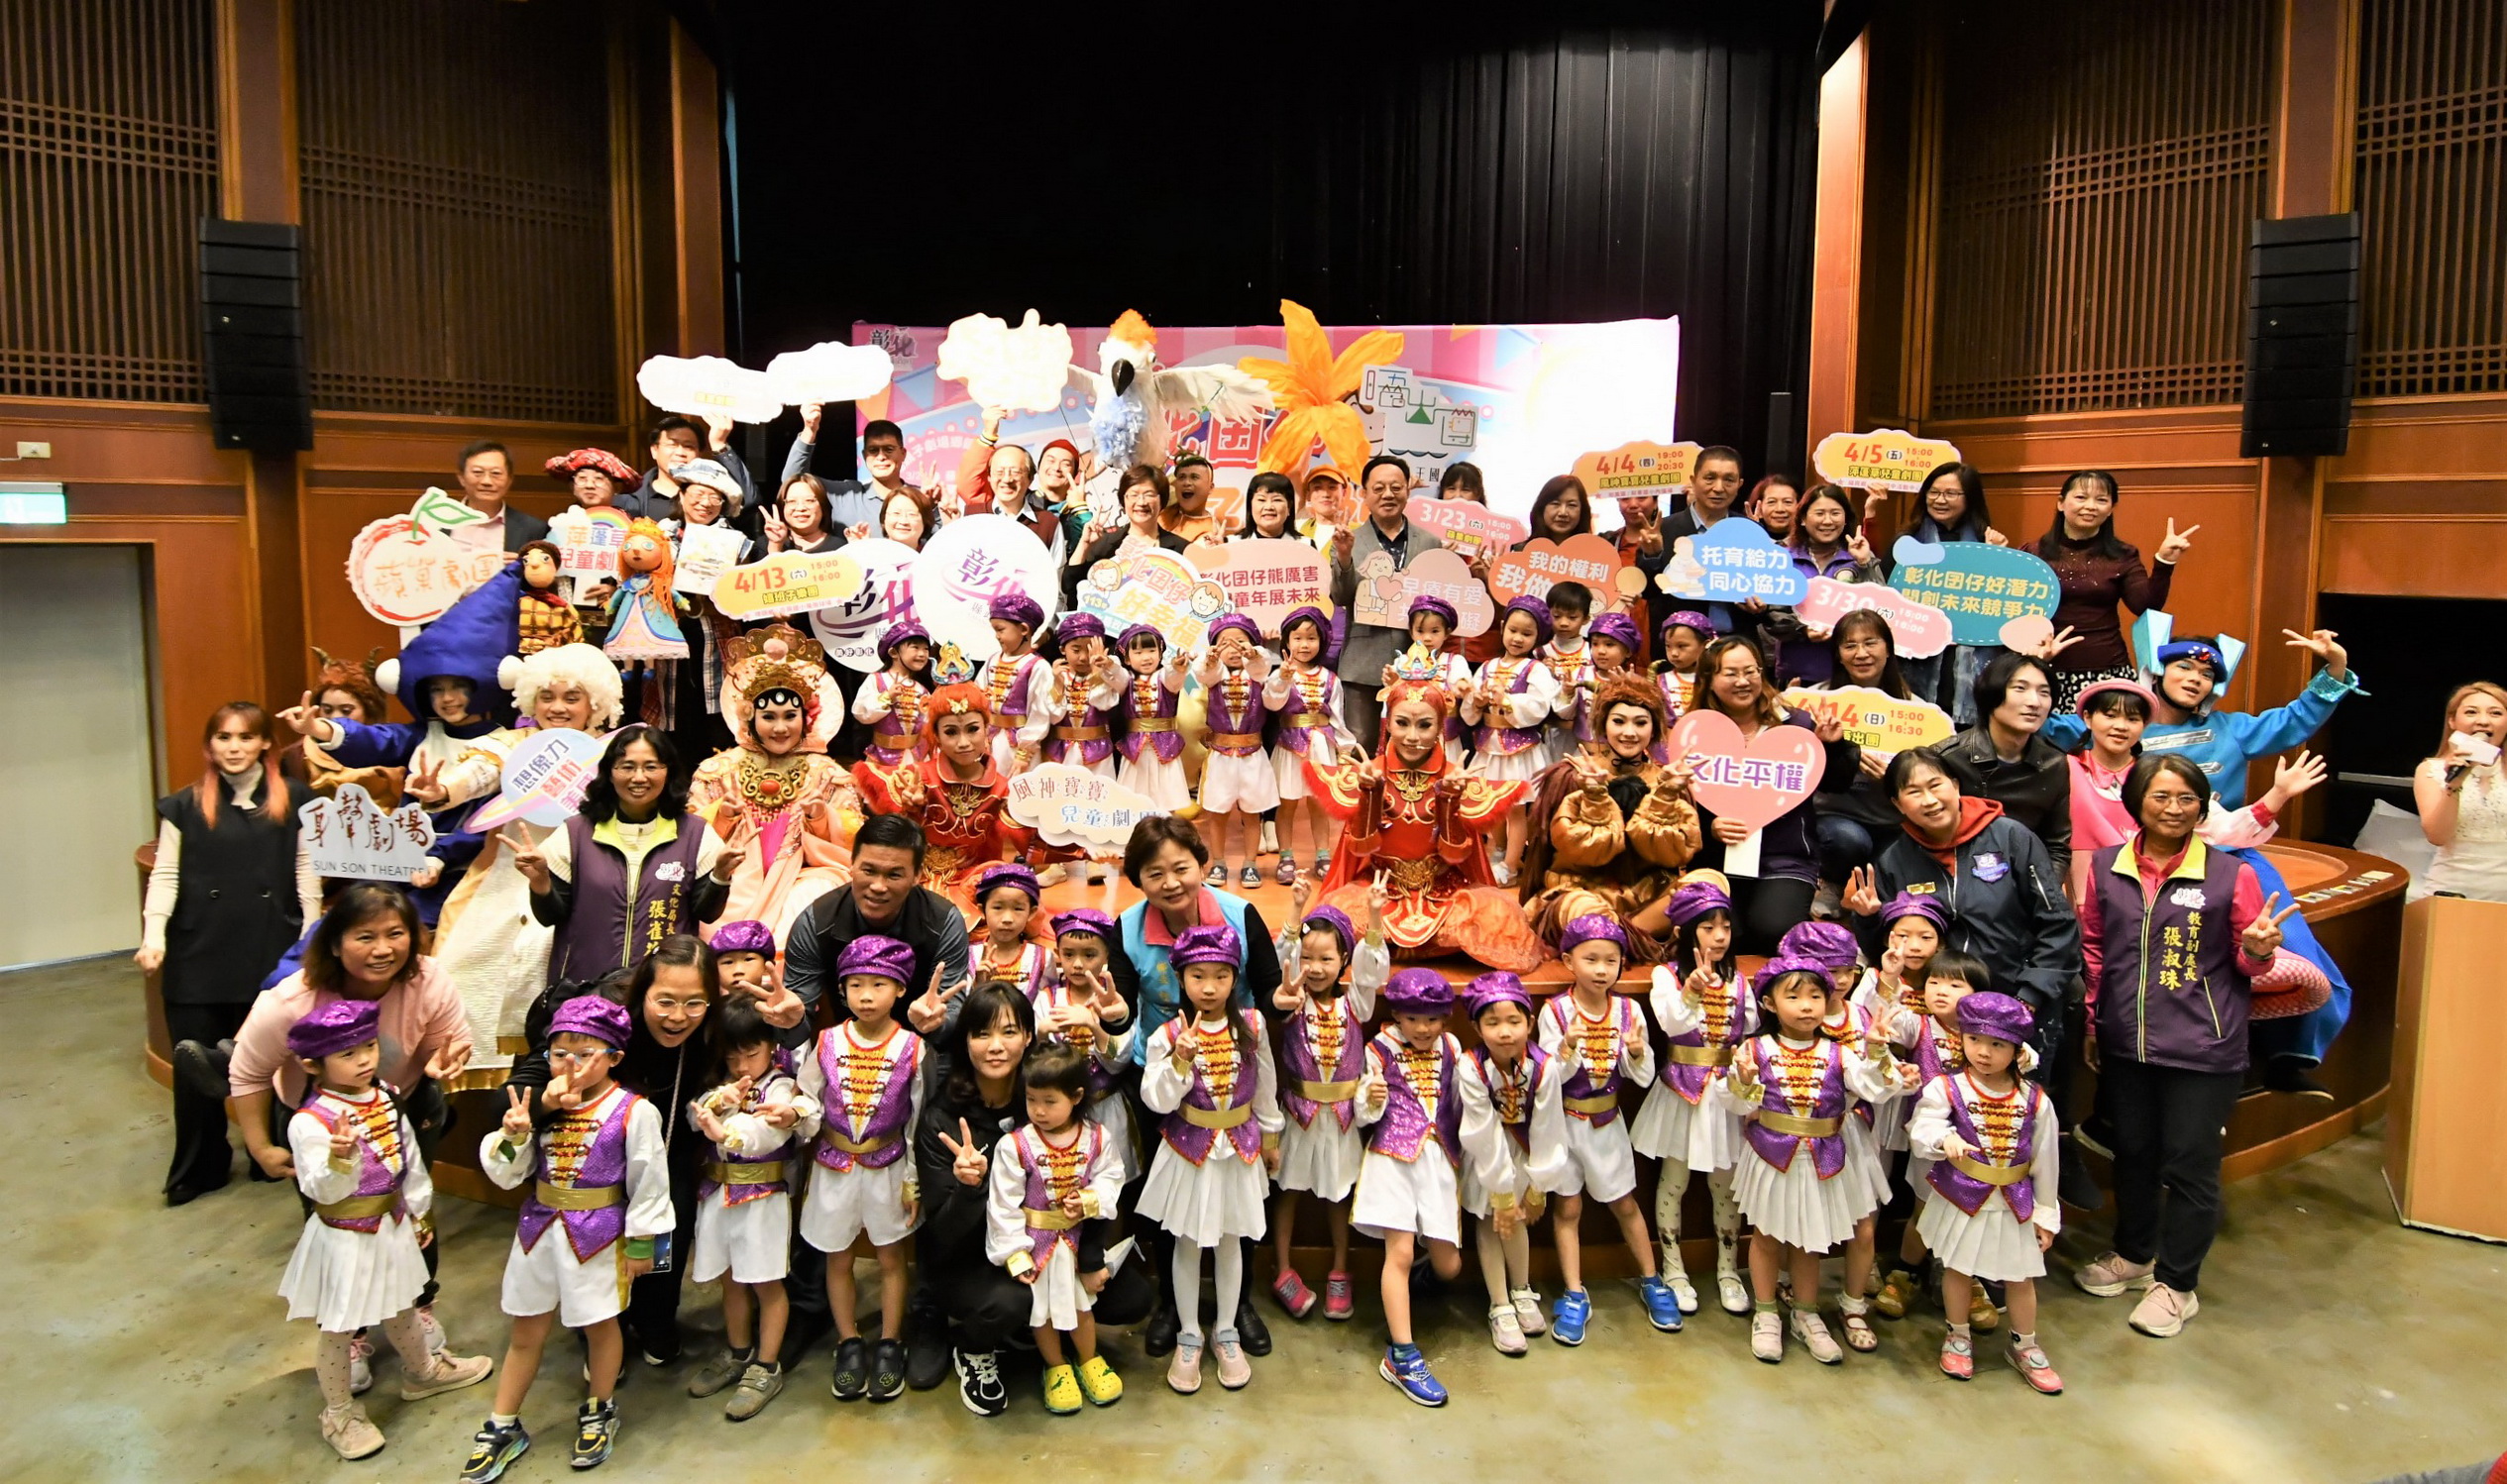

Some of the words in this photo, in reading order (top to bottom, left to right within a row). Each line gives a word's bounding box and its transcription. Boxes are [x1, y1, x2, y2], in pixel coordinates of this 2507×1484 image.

[1657, 451, 1684, 460] 19:00
[1844, 442, 1883, 464] 4/5
[1886, 450, 1903, 461] (五)
[1906, 447, 1933, 457] 15:00
[1596, 454, 1635, 476] 4/4
[1639, 458, 1655, 468] (四)
[1657, 462, 1684, 472] 20:30
[1905, 460, 1931, 469] 16:00
[1420, 503, 1466, 530] 3/23
[1469, 519, 1484, 530] (六)
[561, 550, 619, 572] 兒童劇
[810, 560, 839, 571] 15:00
[1528, 551, 1609, 583] 我的權利
[1701, 546, 1789, 570] 托育給力
[734, 566, 787, 593] 4/13
[789, 569, 809, 581] (六)
[812, 572, 841, 583] 16:00
[1709, 571, 1796, 595] 同心協力
[1904, 566, 2049, 600] 彰化囝仔好潛力
[1231, 586, 1321, 608] 童年展未來
[1402, 578, 1484, 607] 早療有愛
[1116, 587, 1206, 651] 好幸福
[1899, 607, 1929, 623] 15:00
[1864, 712, 1887, 725] (日)
[1890, 708, 1925, 722] 15:00
[1888, 724, 1924, 737] 16:30
[1686, 754, 1804, 792] 文化平權
[1012, 776, 1109, 803] 風神寶寶
[306, 791, 430, 853] 身聲劇場
[314, 859, 337, 873] SUN
[341, 861, 368, 874] SON
[666, 883, 683, 935] 文化局長
[2182, 910, 2204, 982] 教育副處長
[2158, 926, 2184, 990] 張淑珠
